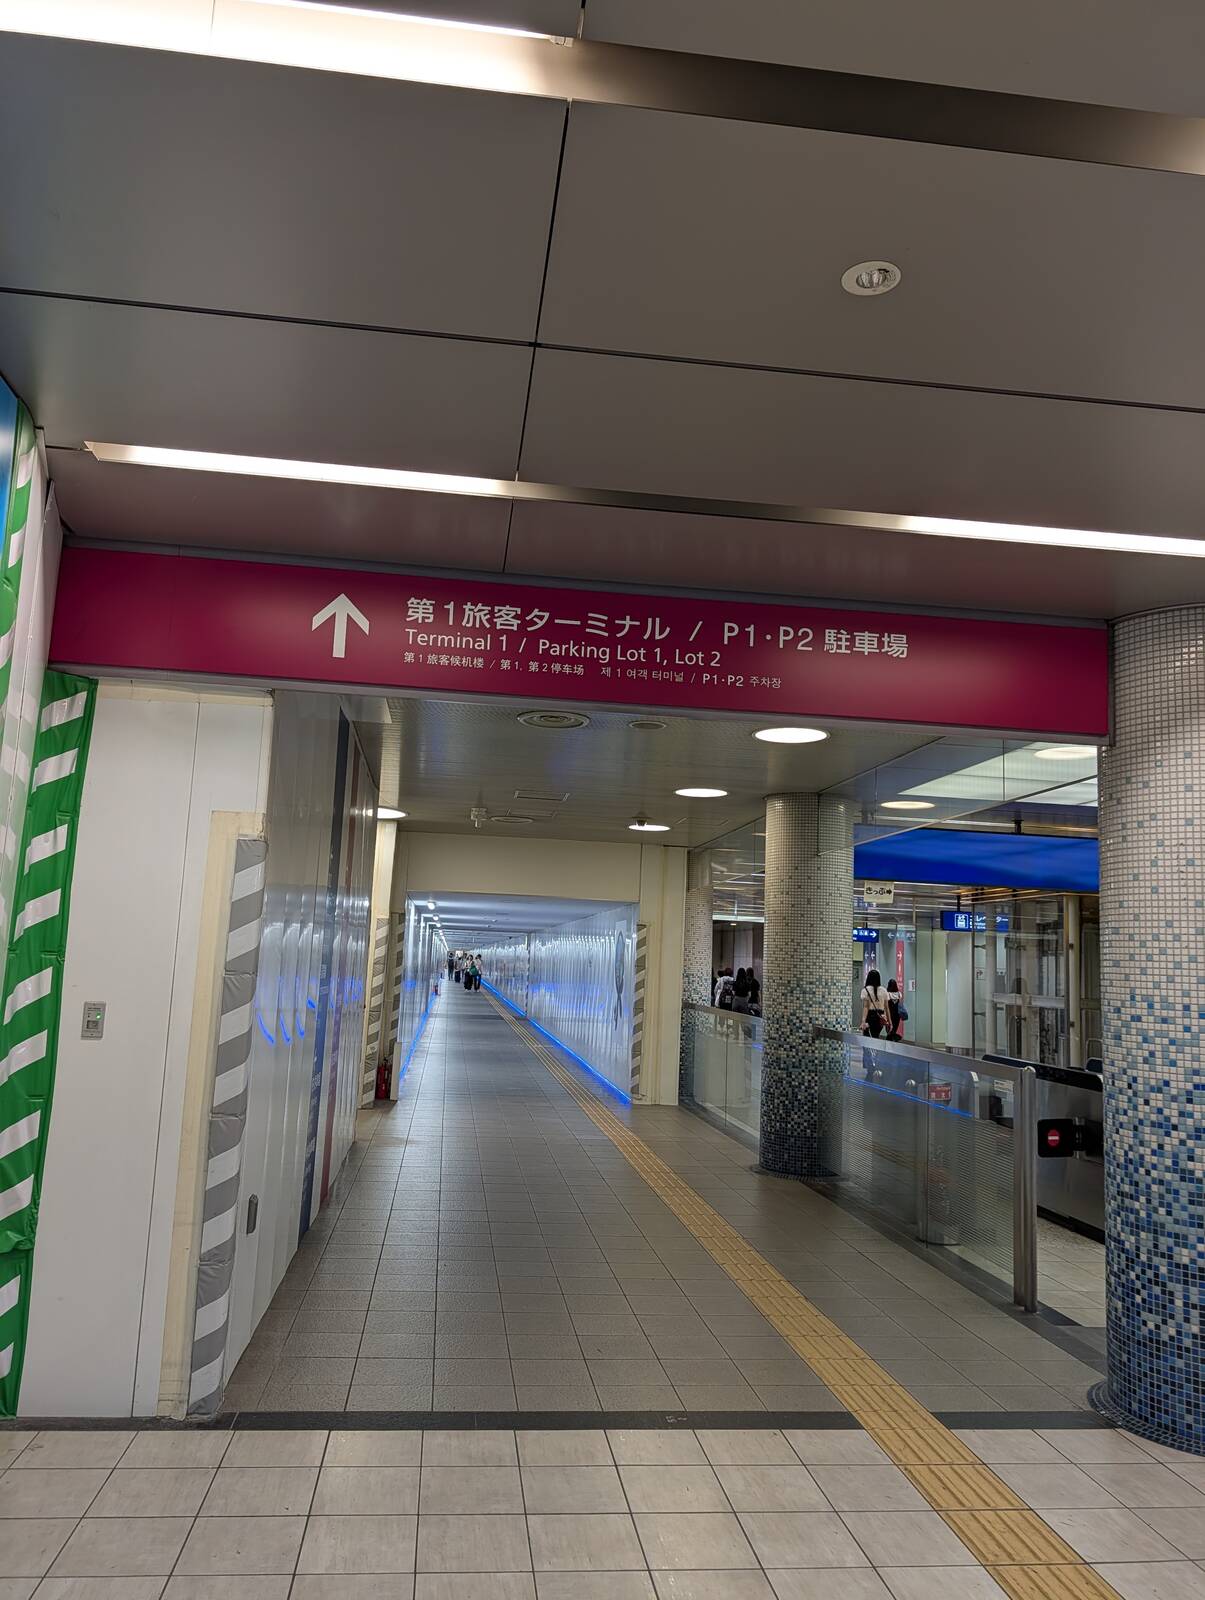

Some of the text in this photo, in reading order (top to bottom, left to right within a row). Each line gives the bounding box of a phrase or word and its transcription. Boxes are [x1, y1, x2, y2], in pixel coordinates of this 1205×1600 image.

[405, 597, 671, 641] 第1旅客ターミナル
[405, 628, 491, 650] Terminal
[499, 634, 507, 652] 1
[538, 639, 610, 663] Parking
[616, 645, 647, 663] Lot
[653, 647, 668, 666] 1,
[675, 648, 705, 666] Lot
[709, 650, 721, 667] 2
[651, 670, 685, 683] 터미널
[750, 676, 782, 688] 주차장
